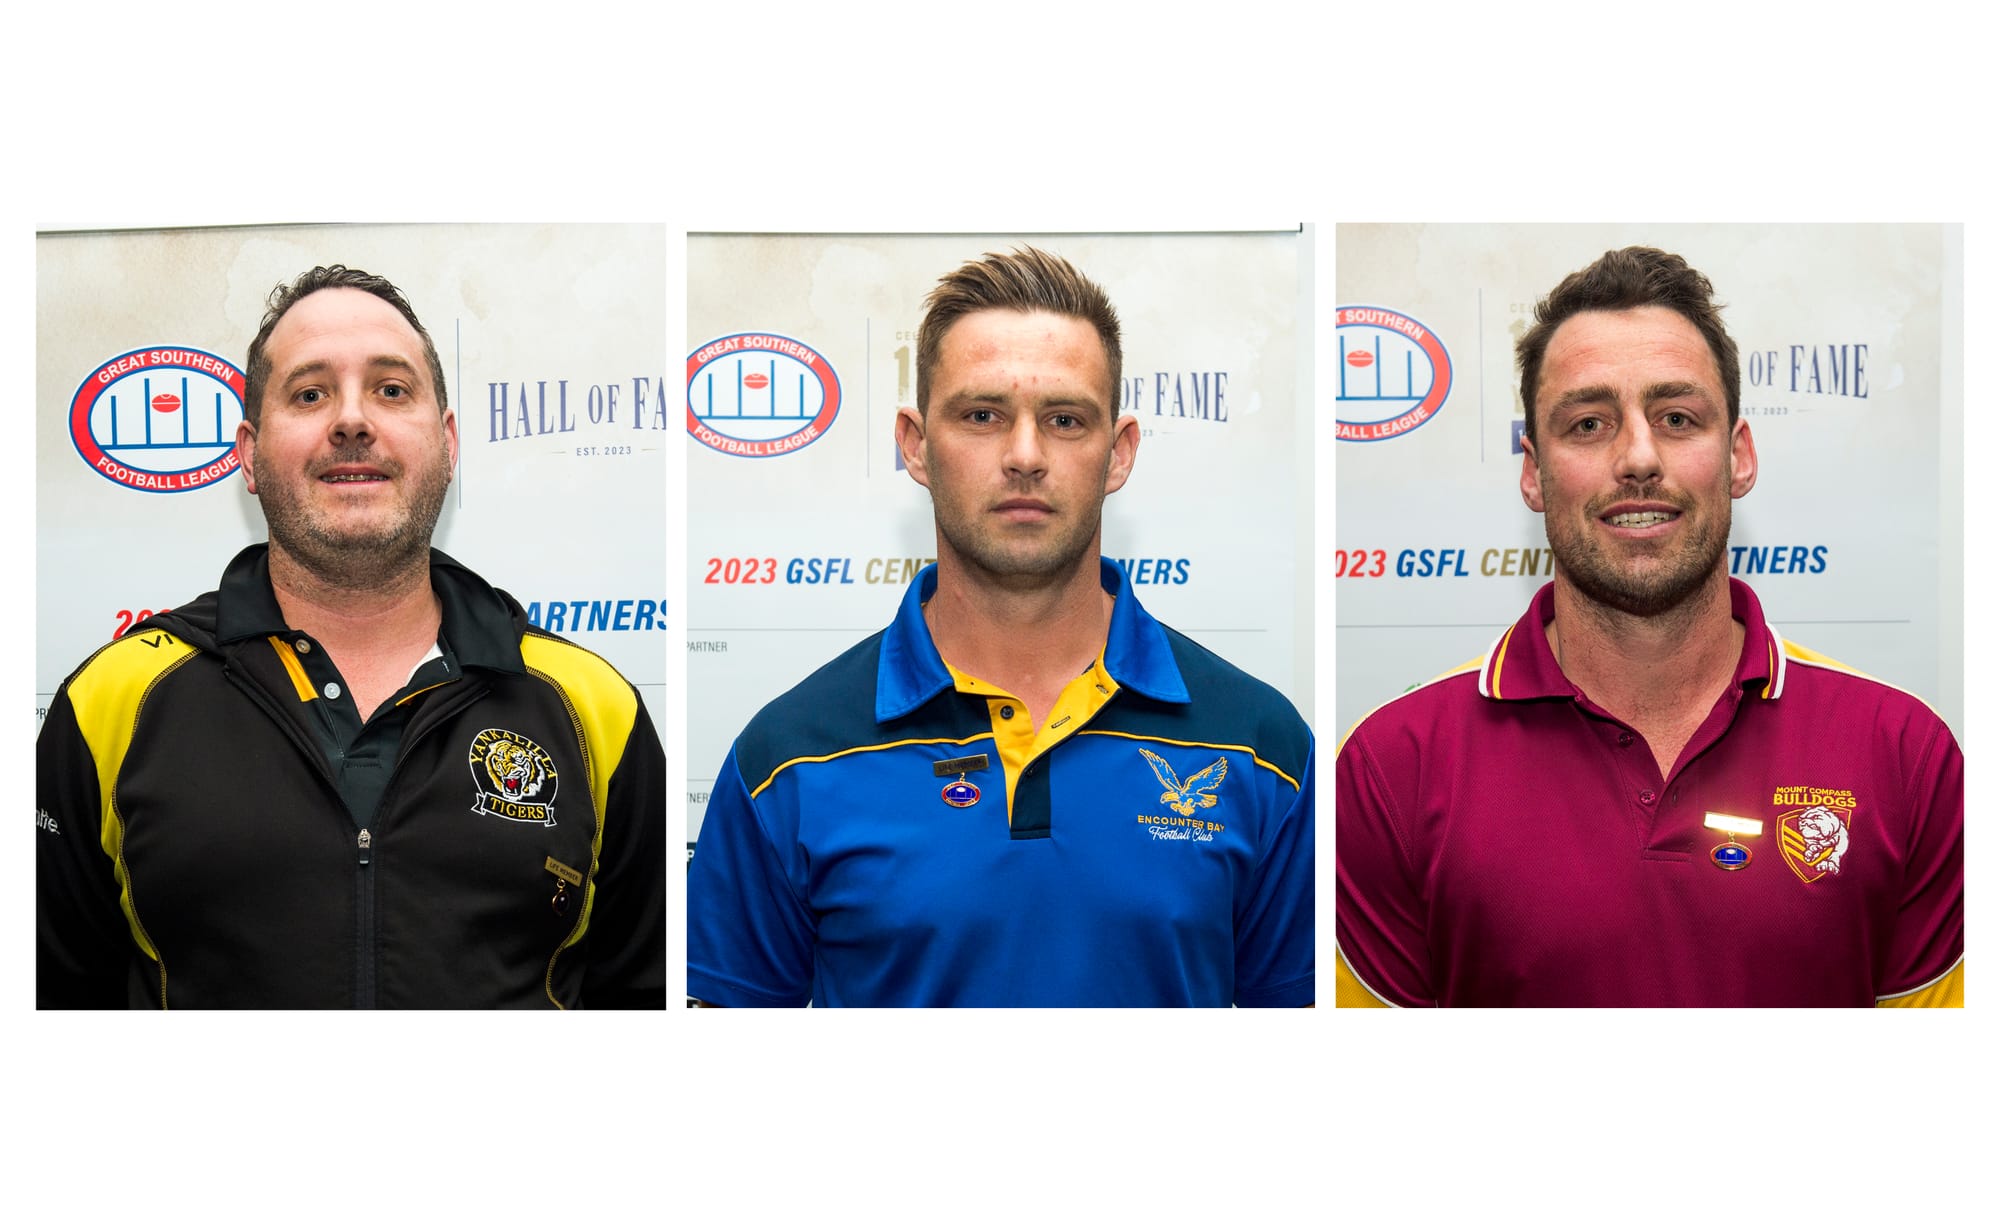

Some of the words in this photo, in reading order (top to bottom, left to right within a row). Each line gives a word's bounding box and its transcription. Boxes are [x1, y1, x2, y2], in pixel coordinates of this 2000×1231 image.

[1345, 310, 1425, 340] SOUTHERN
[697, 338, 740, 364] GREAT
[743, 336, 816, 364] SOUTHERN
[98, 353, 147, 384] GREAT
[150, 351, 234, 382] SOUTHERN
[1749, 350, 1778, 387] OF
[1789, 344, 1869, 399] FAME
[488, 380, 575, 442] HALL
[588, 384, 620, 424] OF
[1155, 372, 1229, 423] FAME
[1373, 406, 1429, 438] LEAGUE
[576, 447, 600, 456] EST.
[604, 446, 632, 455] 2023
[693, 425, 763, 455] FOOTBALL
[767, 424, 818, 454] LEAGUE
[97, 456, 176, 489] FOOTBALL
[180, 453, 240, 488] LEAGUE
[704, 557, 778, 584] 2023
[786, 557, 855, 584] GSFL
[1396, 549, 1469, 577] GSFL
[1731, 545, 1828, 575] TNERS
[470, 729, 558, 780] YANKALILLA
[1773, 793, 1857, 808] BULLDOGS
[1776, 786, 1808, 794] MOUNT
[1809, 787, 1852, 797] COMPASS
[490, 797, 545, 819] TIGERS
[1137, 815, 1205, 829] ENCOUNTER
[1207, 822, 1225, 833] BAY
[1148, 825, 1191, 841] Football
[1191, 827, 1214, 842] Club
